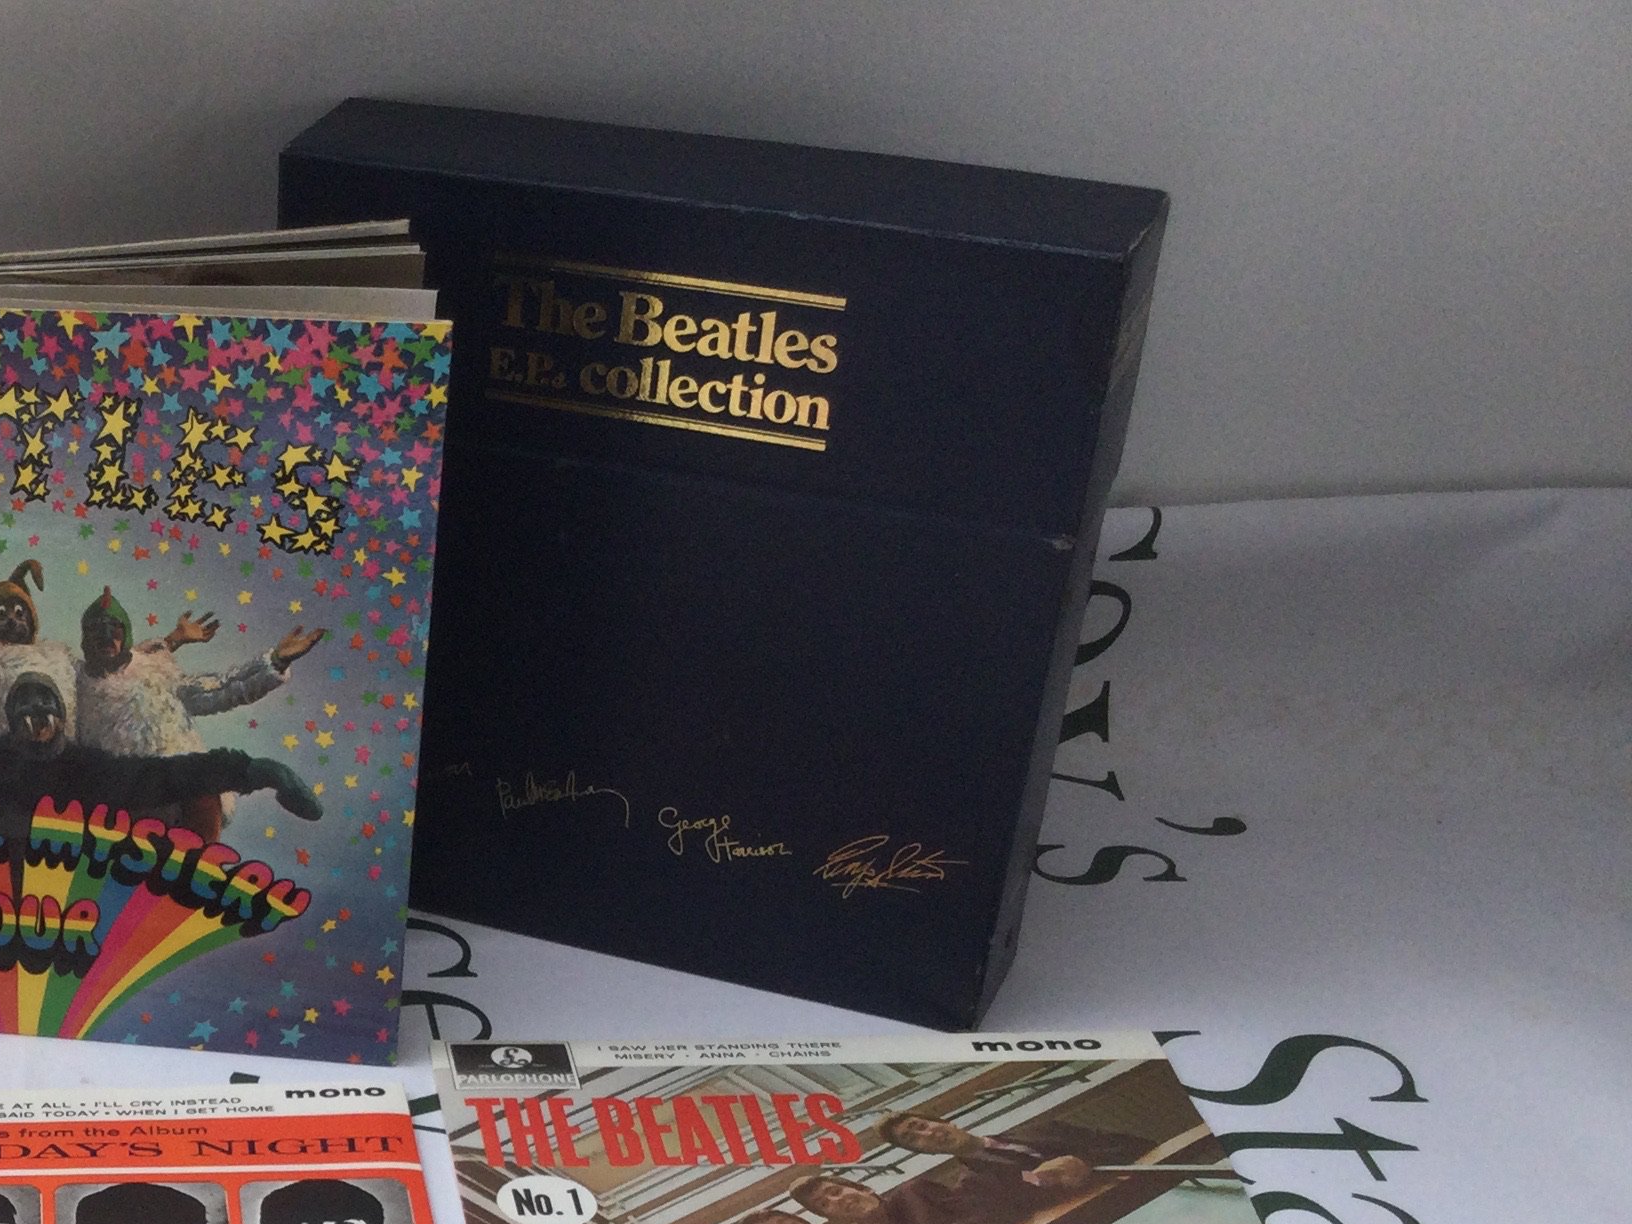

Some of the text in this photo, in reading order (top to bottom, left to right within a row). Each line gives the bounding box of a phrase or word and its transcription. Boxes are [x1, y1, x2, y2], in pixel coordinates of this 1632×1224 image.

[502, 278, 839, 374] The Beatles
[580, 357, 830, 429] collection
[658, 807, 731, 855] George
[23, 794, 312, 938] MYSTERY
[971, 1039, 1103, 1052] mono
[458, 1072, 578, 1085] PARLOPHONE
[171, 1098, 241, 1106] INSTEAD
[285, 1084, 386, 1099] mono
[42, 1110, 99, 1118] TODAY
[19, 1127, 72, 1138] from
[83, 1126, 119, 1137] the
[130, 1125, 207, 1136] Album
[464, 1093, 863, 1168] THE BEATLES
[190, 1135, 404, 1158] NIGHT
[512, 1188, 585, 1216] No. 1
